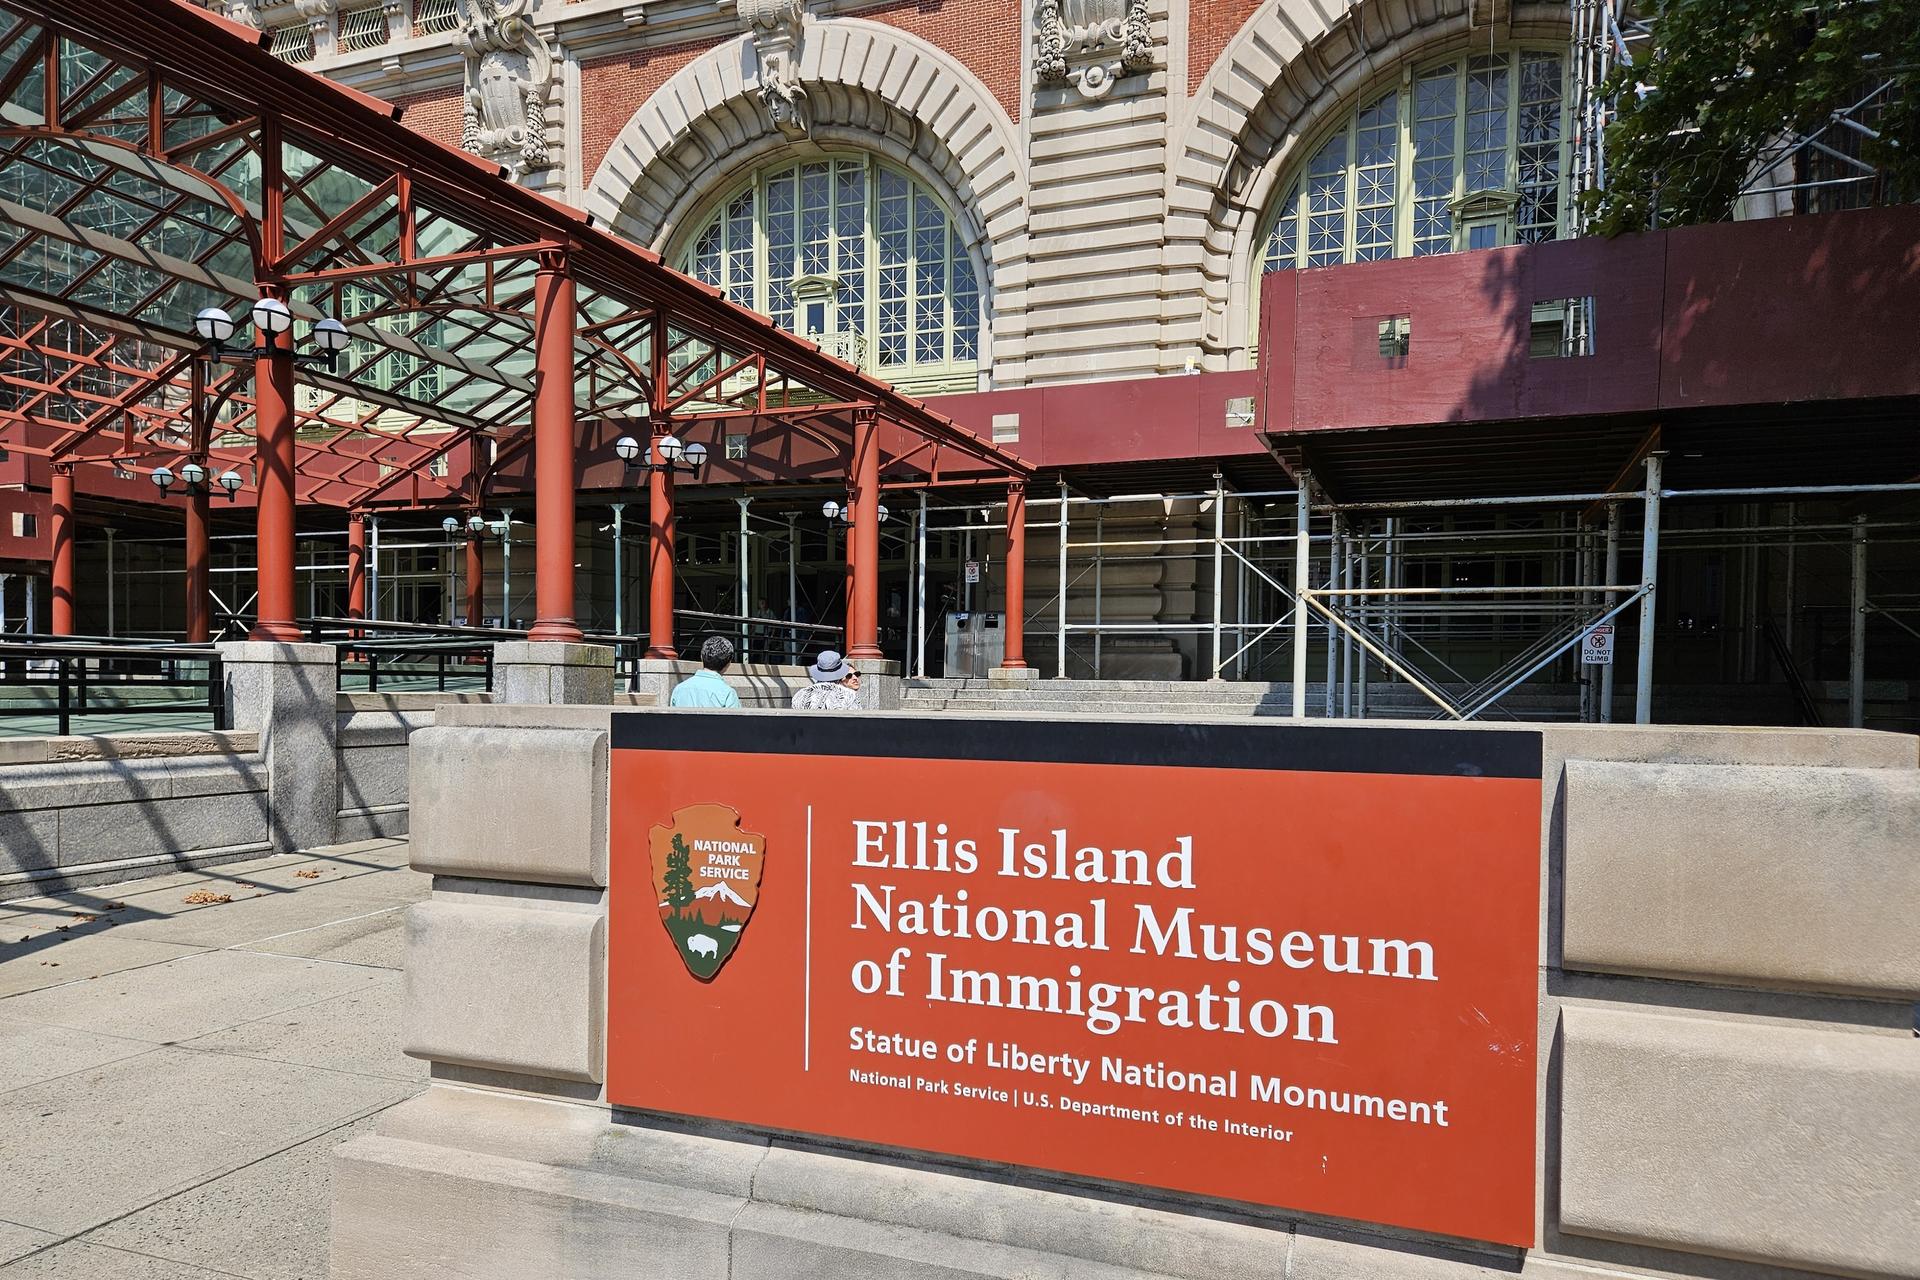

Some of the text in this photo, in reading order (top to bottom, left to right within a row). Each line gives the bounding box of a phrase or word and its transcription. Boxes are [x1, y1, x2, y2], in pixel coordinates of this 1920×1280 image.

[693, 839, 757, 855] NATIONAL
[699, 866, 750, 881] SERVICE
[708, 854, 740, 867] PARK
[851, 820, 1197, 889] Ellis Island
[850, 882, 1439, 981] National Museum
[851, 946, 1339, 1045] of Immigration
[849, 1026, 1449, 1127] Statue of Liberty National Monument
[849, 1068, 911, 1089] National
[916, 1077, 949, 1095] Park
[953, 1082, 1009, 1103] Service
[1023, 1091, 1054, 1109] U.S.
[1060, 1096, 1160, 1124] Department
[1164, 1111, 1184, 1127] of
[1188, 1114, 1218, 1131] the
[1224, 1119, 1294, 1142] Interior
